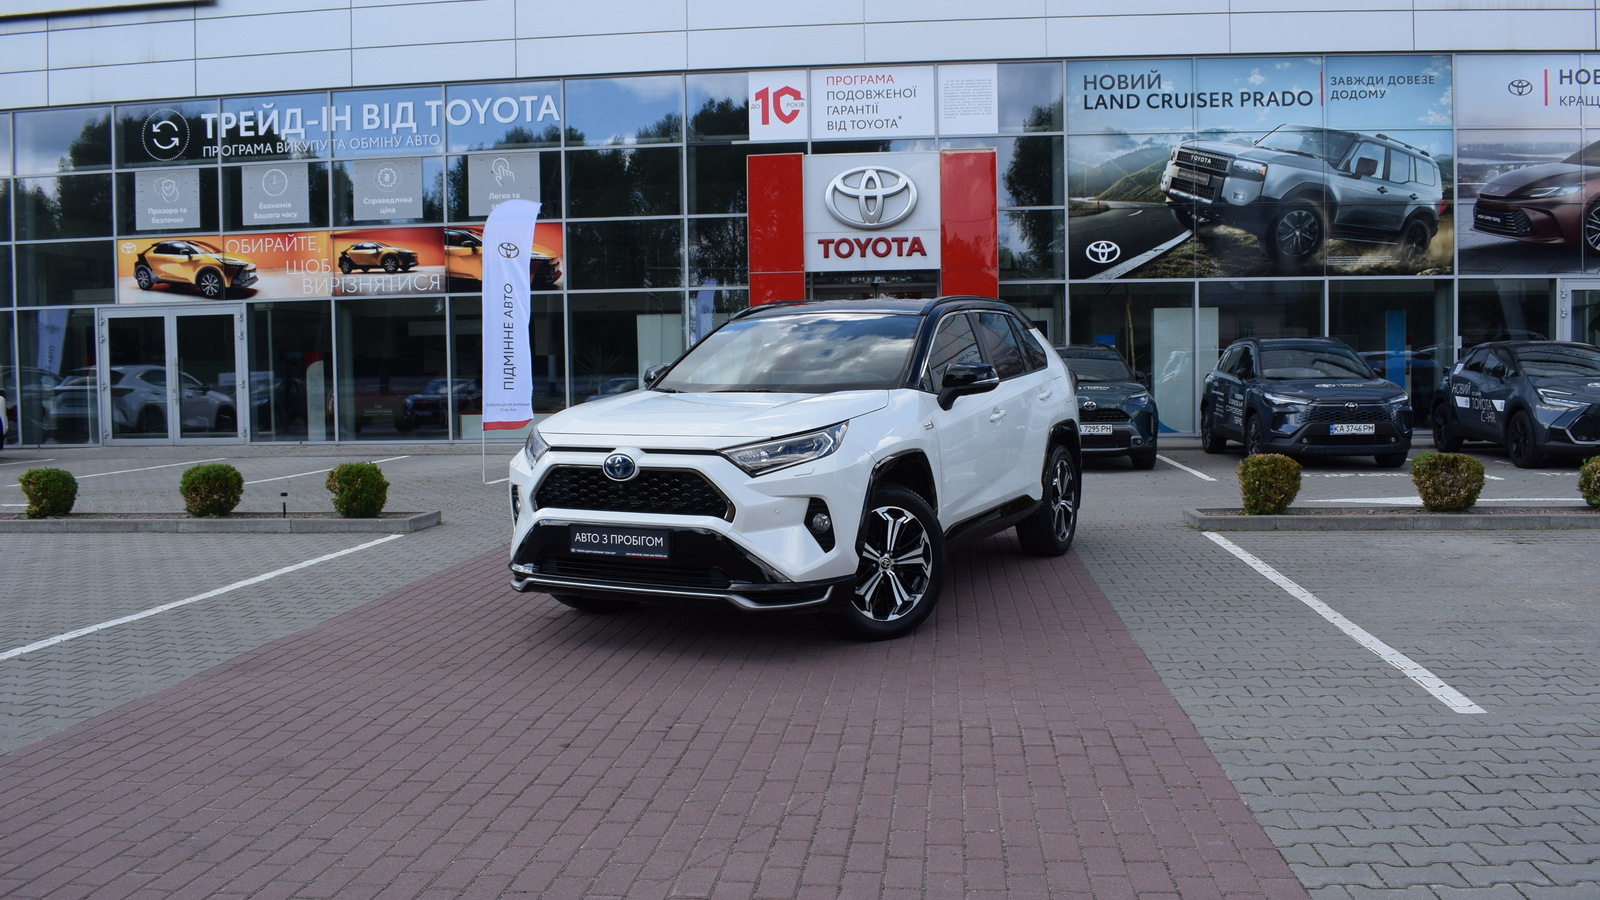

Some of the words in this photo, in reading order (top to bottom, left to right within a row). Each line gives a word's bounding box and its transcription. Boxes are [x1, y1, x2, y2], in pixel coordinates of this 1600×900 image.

[826, 74, 894, 86] ПРОГРАМА
[1083, 69, 1162, 91] НОВИЙ
[1330, 75, 1385, 87] ЗАВЖДИ
[1387, 75, 1435, 86] ДОВЕЗЕ
[826, 86, 917, 102] ПОДОВЖЕНОЇ
[1083, 93, 1141, 110] LAND
[1145, 91, 1234, 109] CRUISER
[1240, 90, 1314, 107] PRADO
[1330, 89, 1387, 101] ДОДОМУ
[754, 85, 802, 126] 10
[826, 102, 879, 116] ГАРАНТІЇ
[201, 103, 351, 139] ТРЕЙД-ІН
[362, 101, 417, 134] ВІД
[425, 95, 561, 127] TOYOTA
[827, 119, 847, 132] ВІД
[203, 143, 273, 157] ПРОГРАМА
[276, 139, 328, 154] ВИКУПУ
[331, 138, 346, 150] ТА
[350, 136, 404, 149] ОБМІНУ
[406, 133, 441, 147] АВТО
[363, 197, 413, 205] Справедлива
[488, 192, 511, 200] Легко
[147, 207, 179, 215] Прозоро
[259, 201, 292, 210] Економія
[380, 206, 396, 214] ціна
[151, 216, 184, 224] безпечно
[281, 211, 298, 219] часу
[225, 233, 322, 254] ОБИРАЙТЕ,
[817, 236, 928, 259] TOYOTA
[285, 258, 332, 276] ЩОБ
[302, 273, 440, 295] ВИРІЗНЯТИСЯ
[503, 283, 514, 319] АВТО
[503, 322, 516, 390] ПІДМІННЕ
[1471, 398, 1493, 411] TOYOTA
[574, 532, 600, 544] АВТО
[610, 534, 664, 547] ПРОБІГОМ
